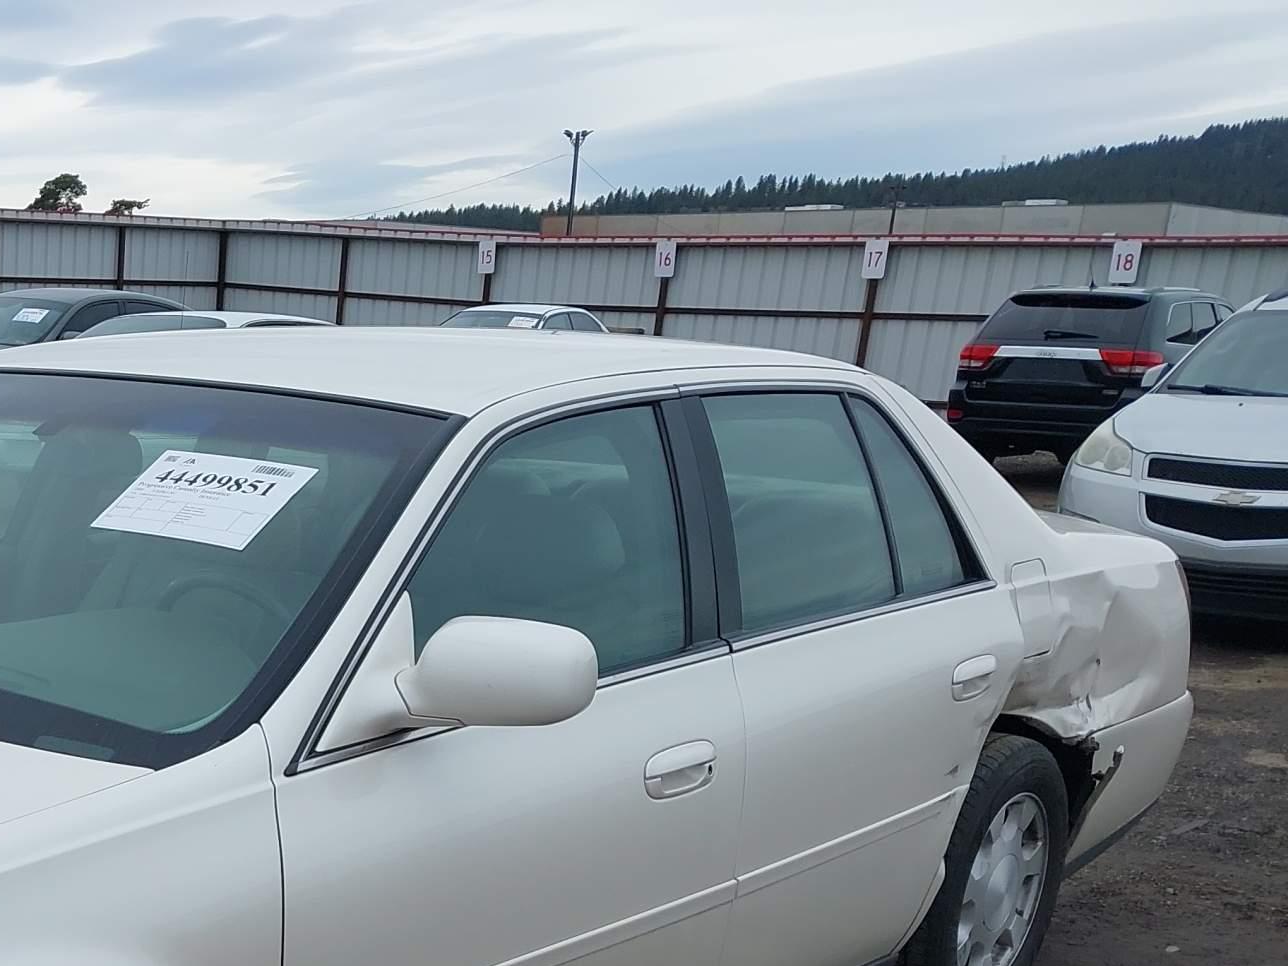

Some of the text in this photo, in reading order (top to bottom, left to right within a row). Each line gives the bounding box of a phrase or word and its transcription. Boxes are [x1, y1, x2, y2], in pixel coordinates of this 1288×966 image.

[481, 249, 492, 264] 15
[659, 251, 672, 267] 16
[867, 251, 883, 268] 17
[1115, 253, 1134, 272] 18
[155, 468, 278, 497] 44499851
